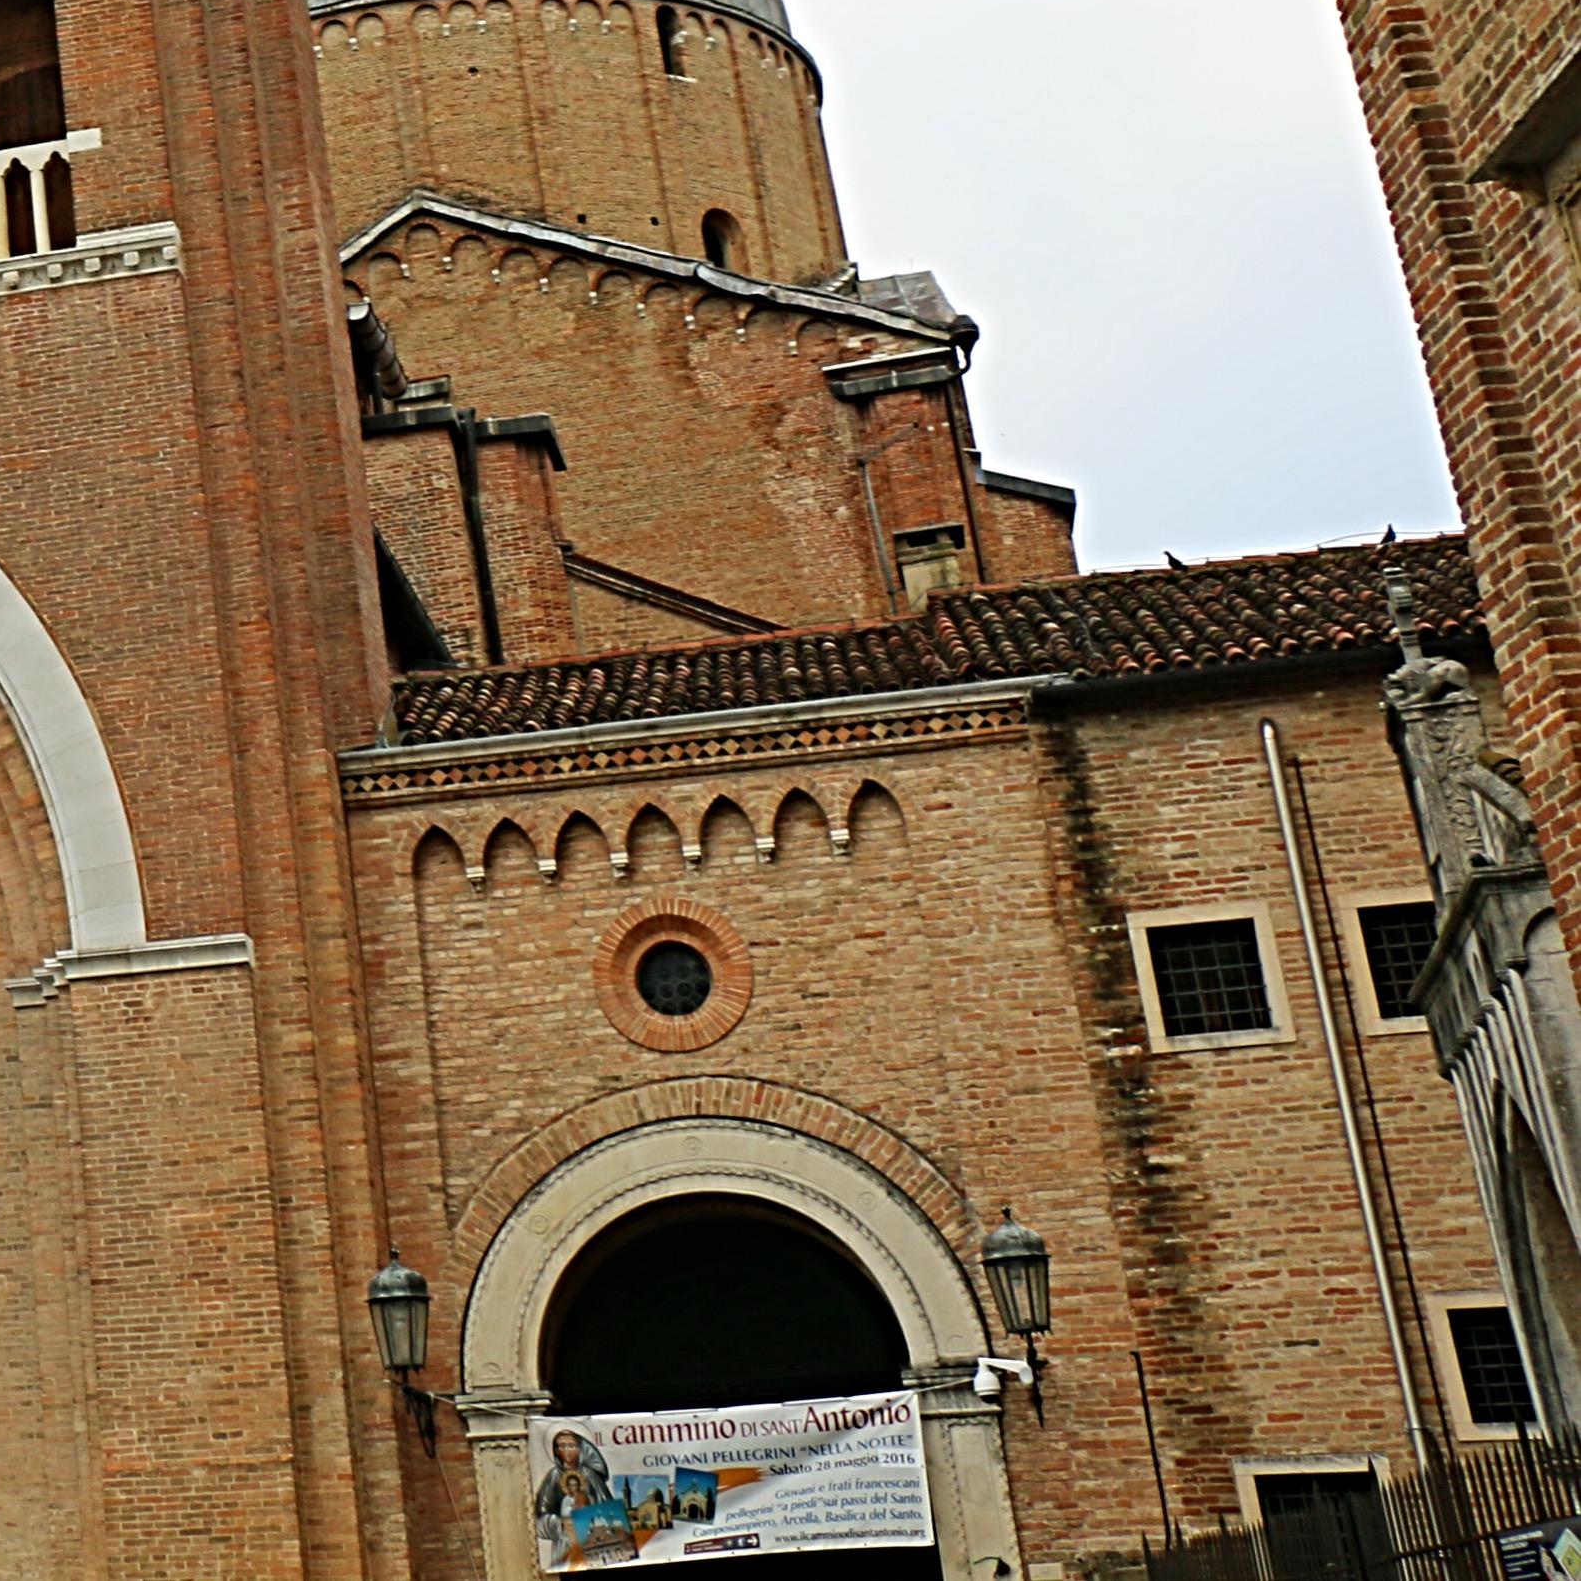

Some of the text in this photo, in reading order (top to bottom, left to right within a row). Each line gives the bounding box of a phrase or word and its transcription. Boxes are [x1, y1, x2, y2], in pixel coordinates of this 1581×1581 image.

[594, 1431, 606, 1447] IL
[611, 1414, 736, 1446] cammino
[740, 1421, 757, 1437] DI
[642, 1451, 708, 1467] GIOVANI
[712, 1446, 796, 1464] PELLEGRINI
[769, 1452, 915, 1476] Sabato 28 maggio 2016
[774, 1483, 816, 1500] Giovani
[855, 1476, 920, 1490] francescani
[726, 1503, 774, 1522] pellegrini
[841, 1493, 868, 1509] passi
[870, 1492, 888, 1505] del
[891, 1492, 923, 1505] Santo
[825, 1508, 866, 1523] Basilica
[869, 1507, 887, 1520] del
